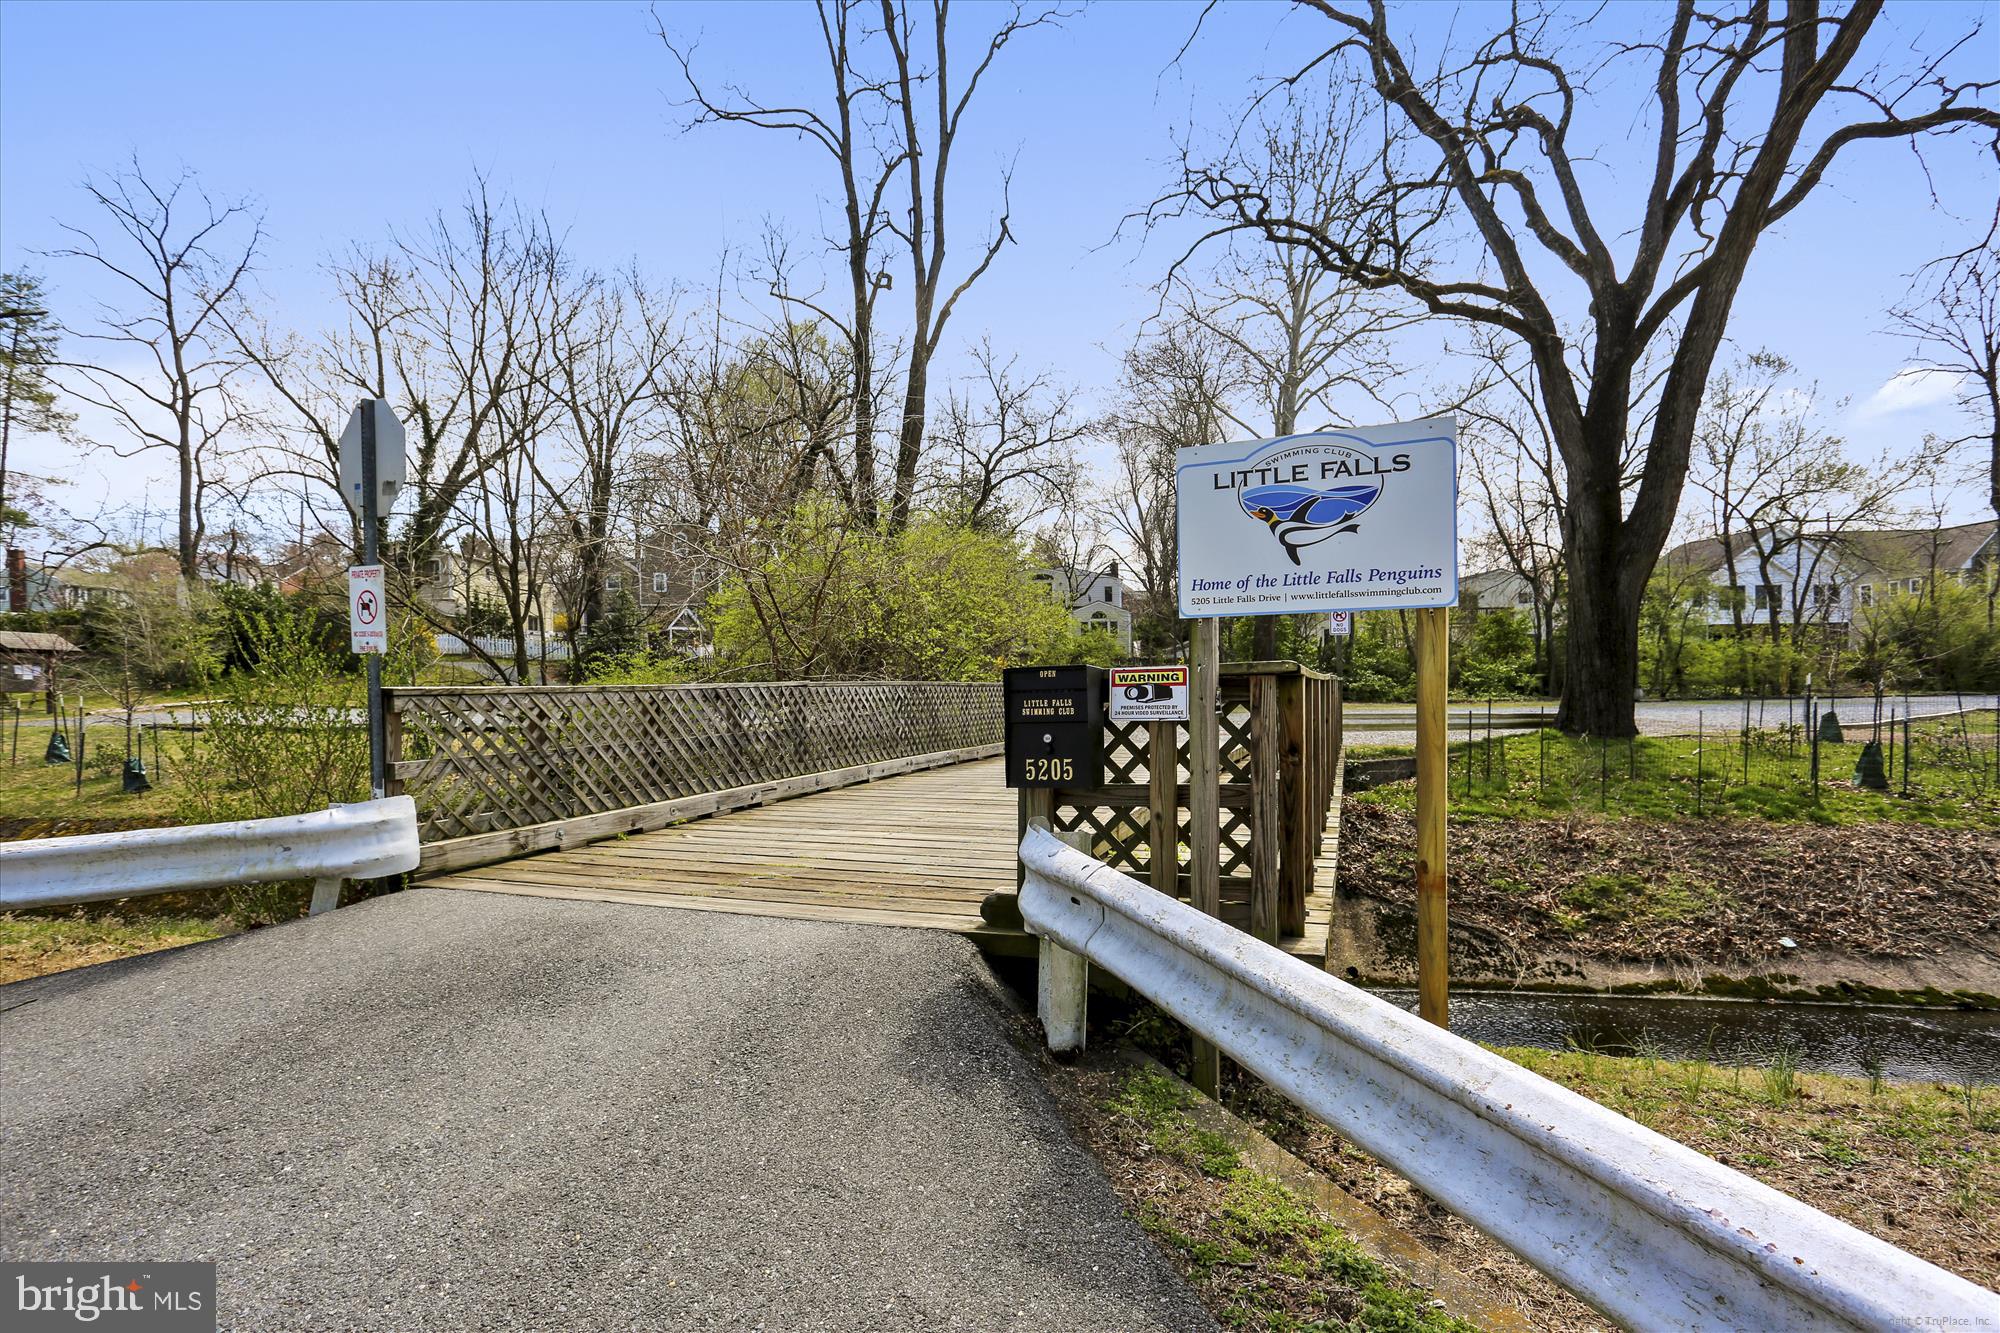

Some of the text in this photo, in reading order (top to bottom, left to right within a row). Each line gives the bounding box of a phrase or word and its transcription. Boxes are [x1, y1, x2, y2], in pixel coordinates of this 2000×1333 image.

[1265, 447, 1353, 468] SWIMMING CLUB
[1213, 453, 1412, 490] LITTLE FALLS
[1191, 564, 1443, 593] Home of the Little Falls Penguins
[1191, 596, 1211, 606] 5205
[1213, 595, 1235, 605] Little
[1236, 594, 1256, 603] Falls
[1258, 592, 1281, 602] Drive
[1290, 586, 1442, 601] www.littlefallsswimmingclub.com
[1039, 670, 1057, 678] OPEN
[1117, 673, 1180, 683] WARNING
[1023, 699, 1073, 708] LITTLE FALLS
[1021, 707, 1075, 716] SWIMMING CLUB
[1149, 708, 1184, 716] SURVEILLANCE
[1025, 758, 1074, 781] 5205
